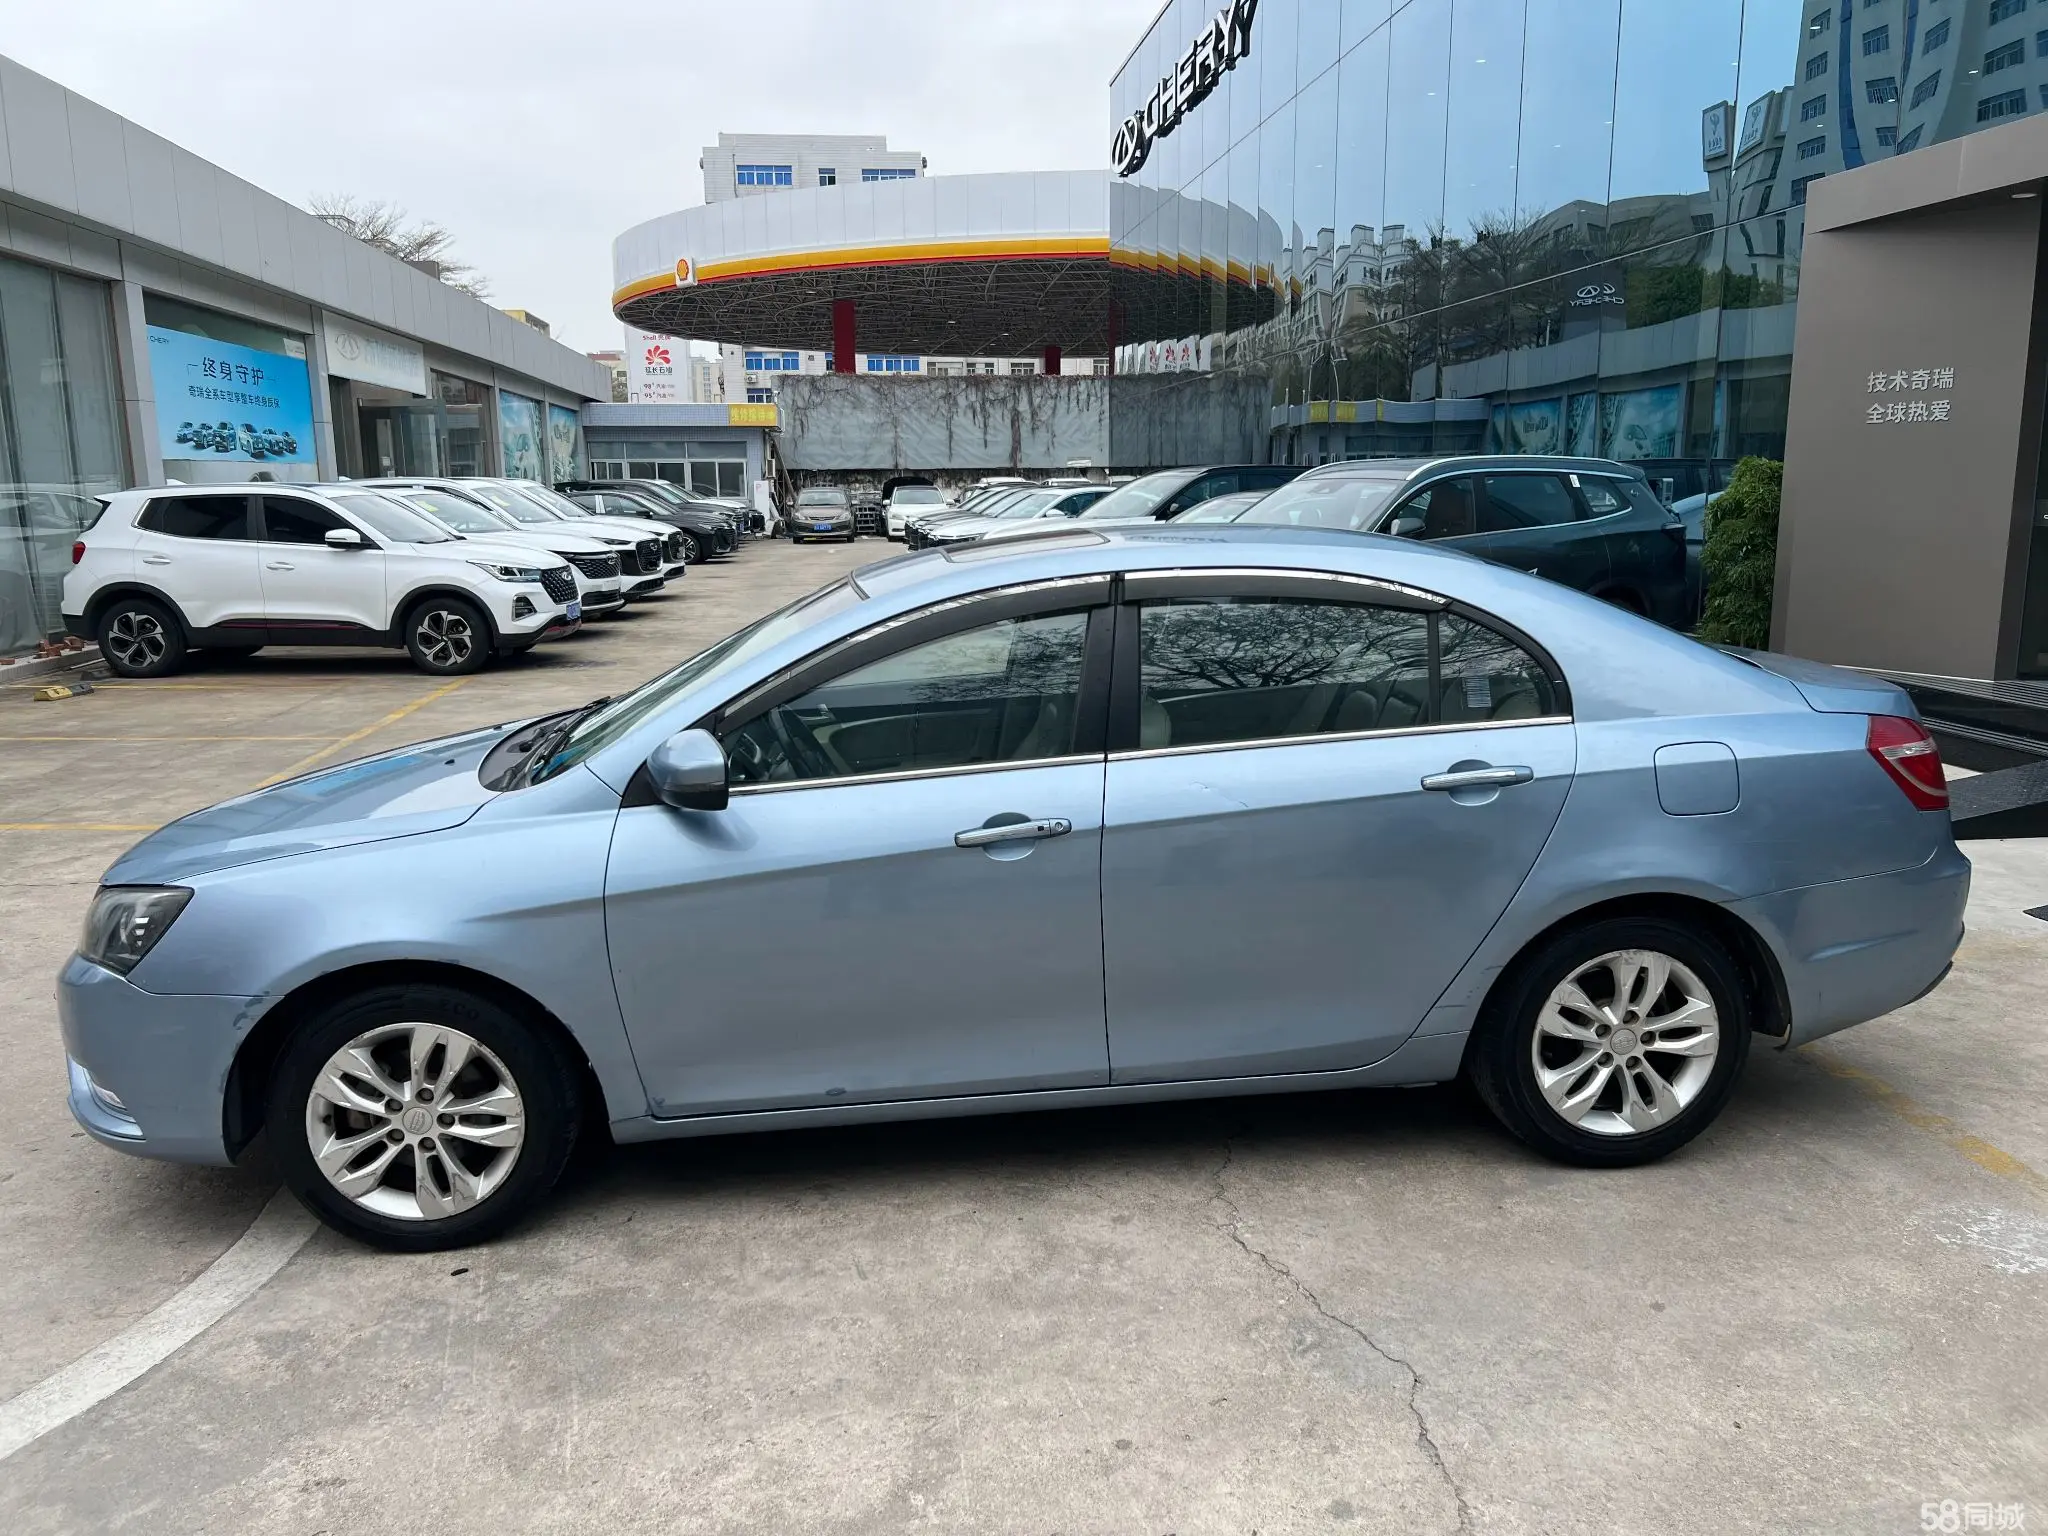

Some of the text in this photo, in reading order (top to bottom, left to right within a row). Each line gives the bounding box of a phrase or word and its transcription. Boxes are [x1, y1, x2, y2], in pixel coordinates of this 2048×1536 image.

[1142, 0, 1239, 139] CHERY
[150, 335, 169, 344] CHERY
[202, 356, 264, 386] 终身守护
[645, 366, 673, 374] 延长石油
[1867, 367, 1954, 393] 技术奇瑞
[1866, 400, 1951, 423] 全球热爱
